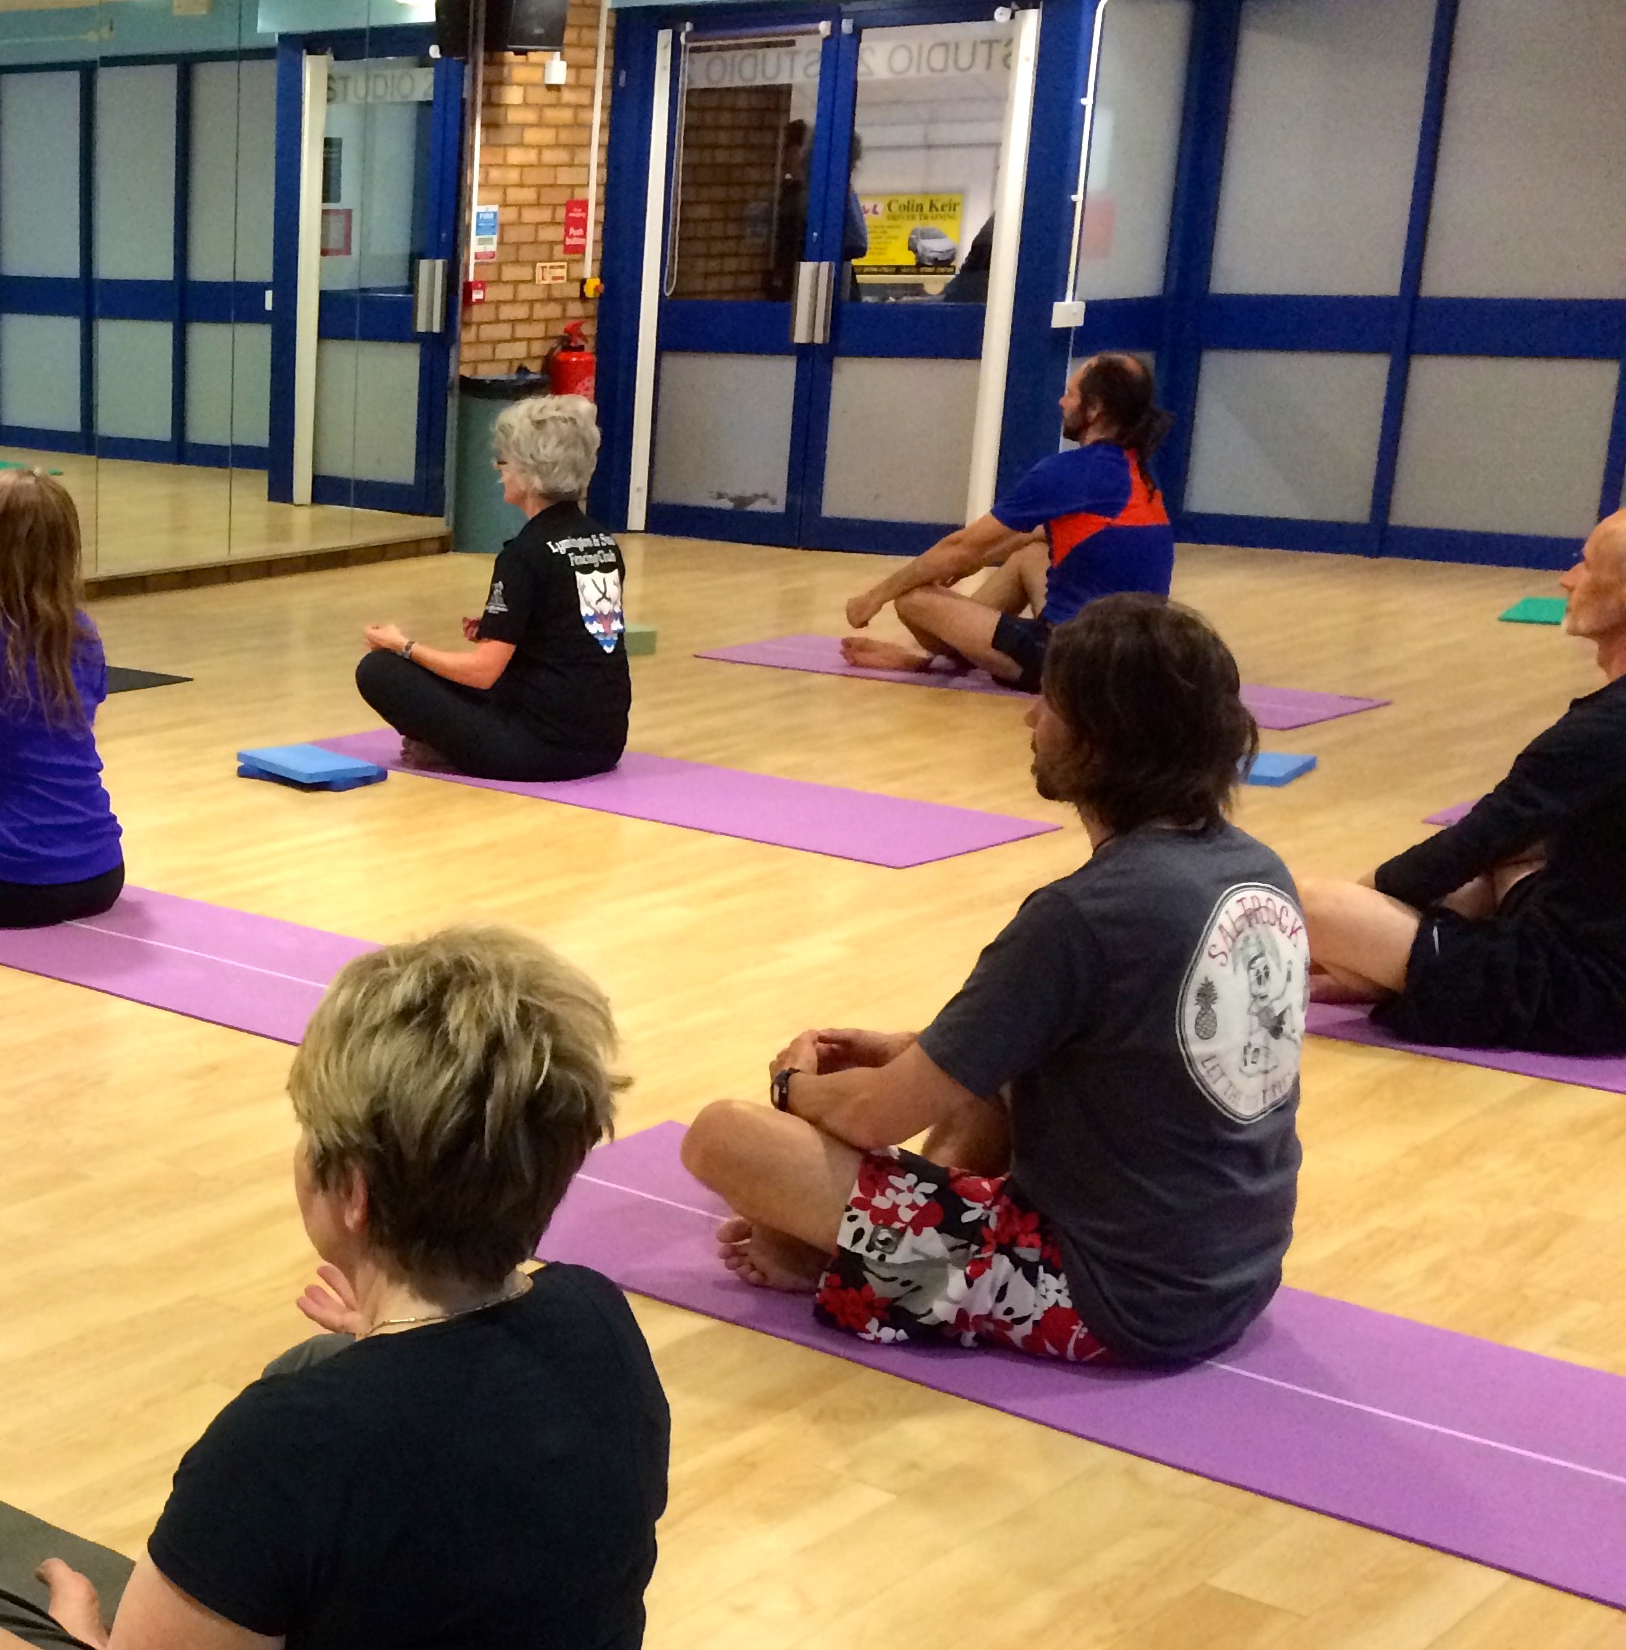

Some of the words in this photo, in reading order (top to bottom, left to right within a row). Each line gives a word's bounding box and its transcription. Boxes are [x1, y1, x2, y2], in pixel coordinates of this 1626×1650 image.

[887, 198, 924, 213] Colin
[928, 197, 960, 213] Keir
[1208, 895, 1303, 968] SALTROCK
